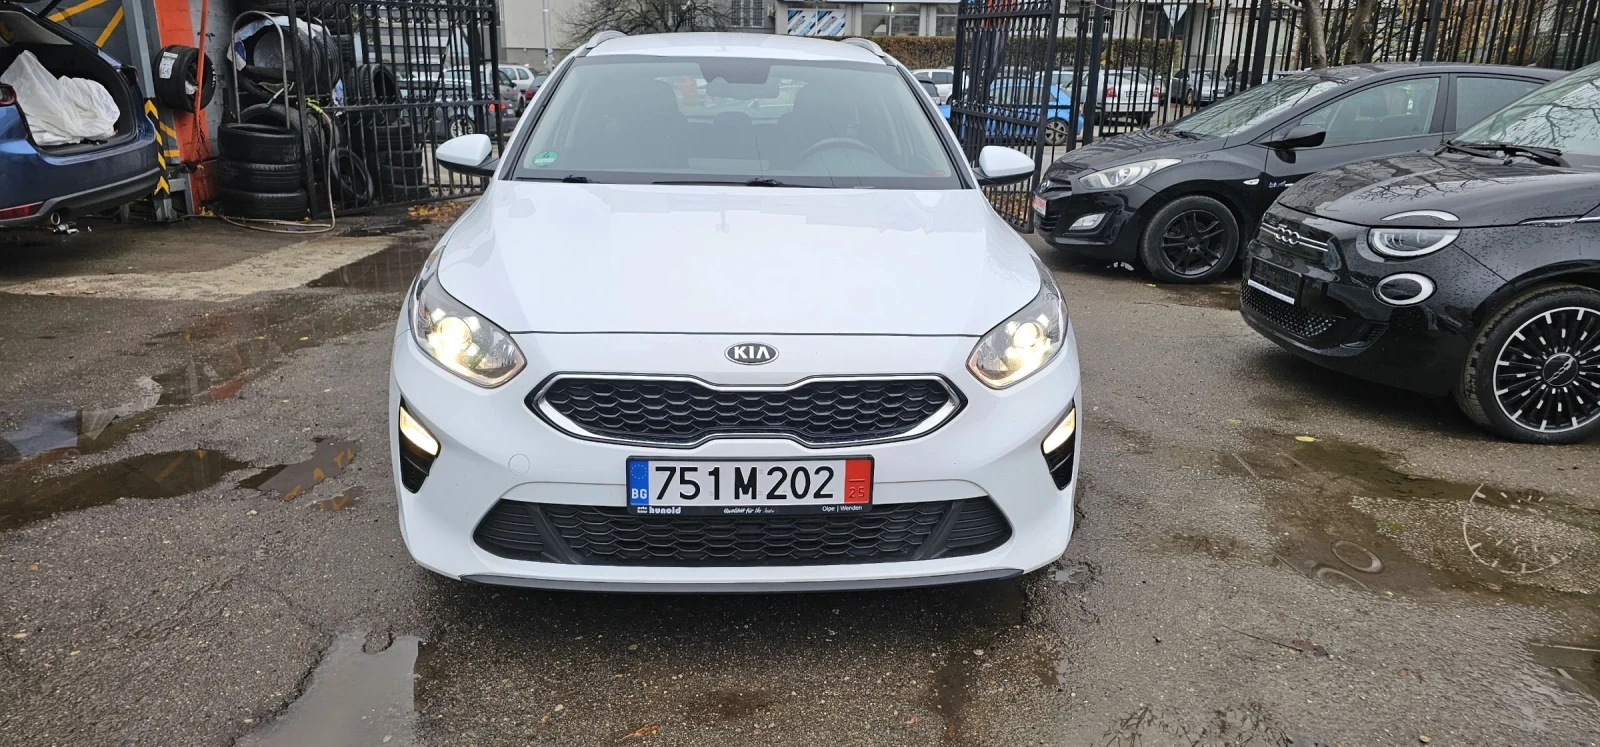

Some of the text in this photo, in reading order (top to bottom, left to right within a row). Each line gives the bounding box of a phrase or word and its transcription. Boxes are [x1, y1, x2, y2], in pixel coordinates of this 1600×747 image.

[734, 346, 771, 360] KIA
[631, 488, 648, 499] BG
[849, 486, 865, 499] 25
[649, 506, 682, 514] hunold
